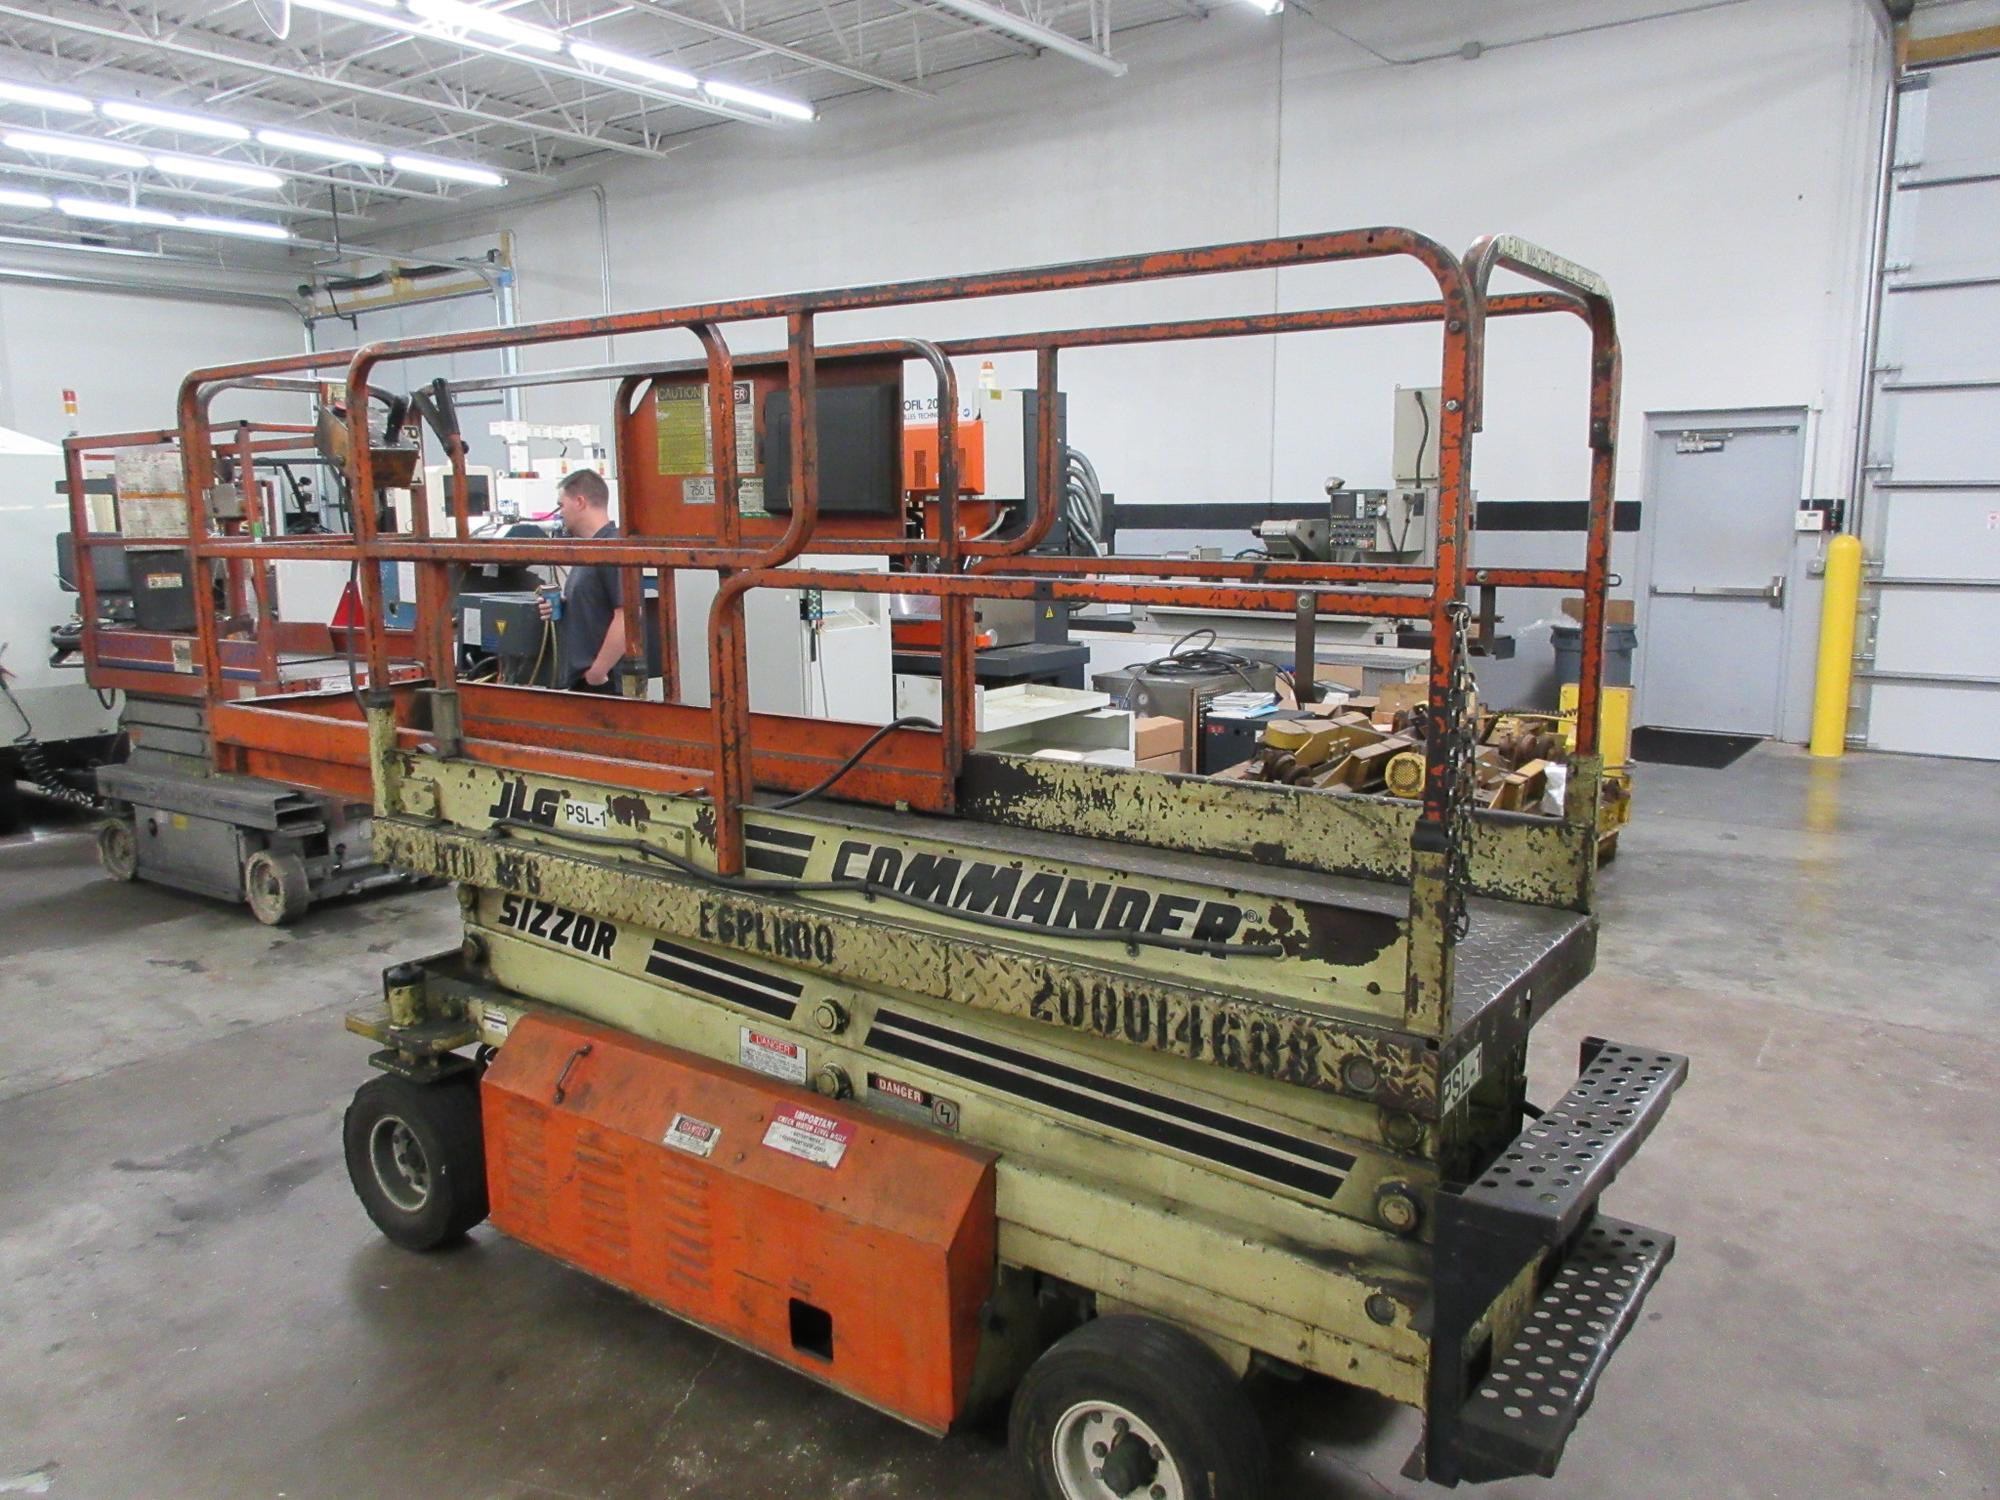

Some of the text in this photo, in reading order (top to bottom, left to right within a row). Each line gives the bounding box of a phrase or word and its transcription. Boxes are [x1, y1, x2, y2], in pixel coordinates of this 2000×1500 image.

[659, 386, 702, 401] CAUTION
[903, 400, 923, 411] OFIL
[690, 485, 705, 497] 750
[488, 779, 561, 828] JLG
[565, 803, 607, 827] PSL-1
[498, 893, 618, 961] SIZZOR
[754, 1034, 791, 1057] DANGER
[878, 1079, 922, 1103] DANGER
[1442, 1046, 1481, 1115] PSL-1
[794, 1109, 839, 1132] IMPORTANT
